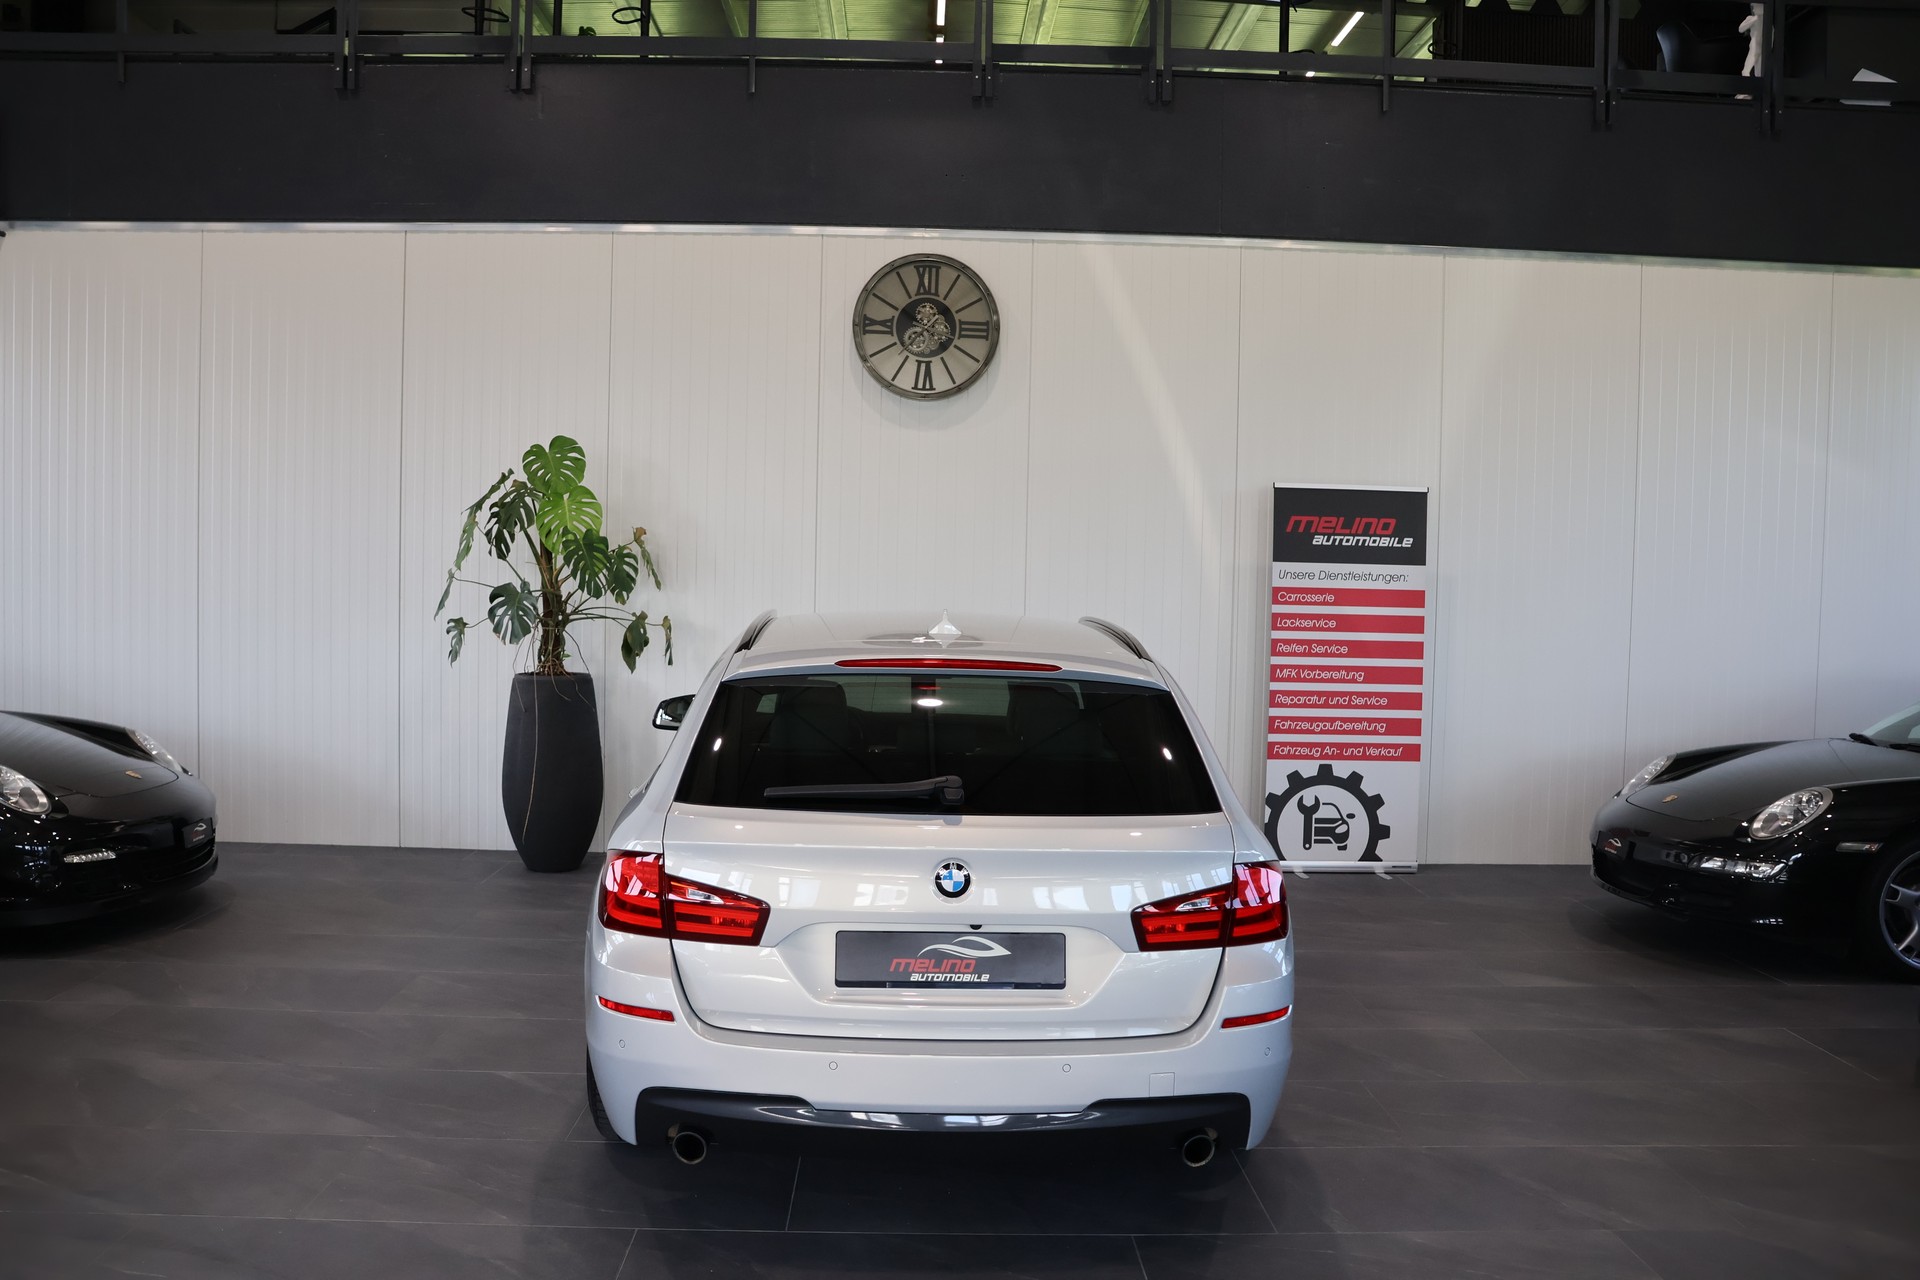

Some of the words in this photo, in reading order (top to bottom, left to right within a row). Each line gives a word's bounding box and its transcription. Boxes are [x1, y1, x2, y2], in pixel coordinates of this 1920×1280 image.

[914, 265, 941, 297] XII
[863, 314, 895, 336] IX
[958, 319, 989, 341] III
[911, 360, 936, 391] VI
[1278, 569, 1315, 580] Unsere
[1318, 570, 1409, 584] Dienstleistungen:
[1277, 591, 1335, 602] Carrosserie
[1277, 617, 1336, 628] Lackservice
[1276, 643, 1309, 653] Reifen
[1311, 643, 1348, 654] Service
[1275, 668, 1298, 678] MFK
[1300, 668, 1364, 681] Vorbereitung
[1275, 694, 1326, 705] Reparatur
[1329, 695, 1349, 705] und
[1351, 695, 1388, 705] Service
[1274, 720, 1386, 733] Fahrzeugaufbereitung
[1273, 745, 1321, 757] Fahrzeug
[1323, 746, 1340, 756] An-
[1343, 746, 1363, 756] und
[1365, 746, 1403, 756] Verkauf
